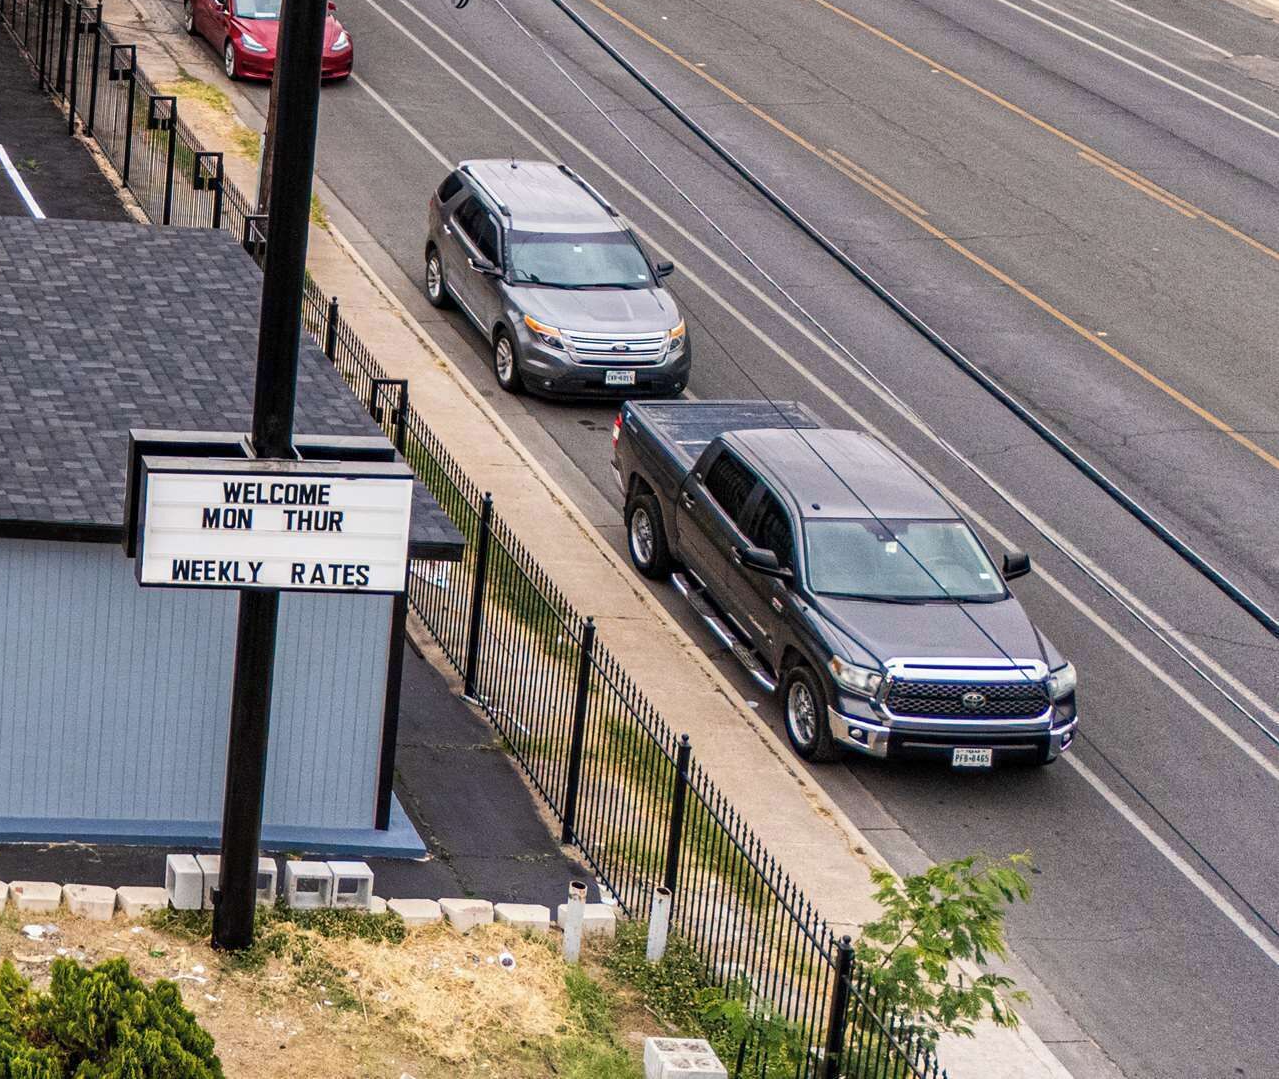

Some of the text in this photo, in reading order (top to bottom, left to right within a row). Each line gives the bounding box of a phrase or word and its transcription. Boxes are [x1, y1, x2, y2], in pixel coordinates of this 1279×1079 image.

[223, 482, 331, 505] WELCOME
[202, 507, 344, 531] MON THUR
[172, 559, 370, 586] WEEKLY RATES
